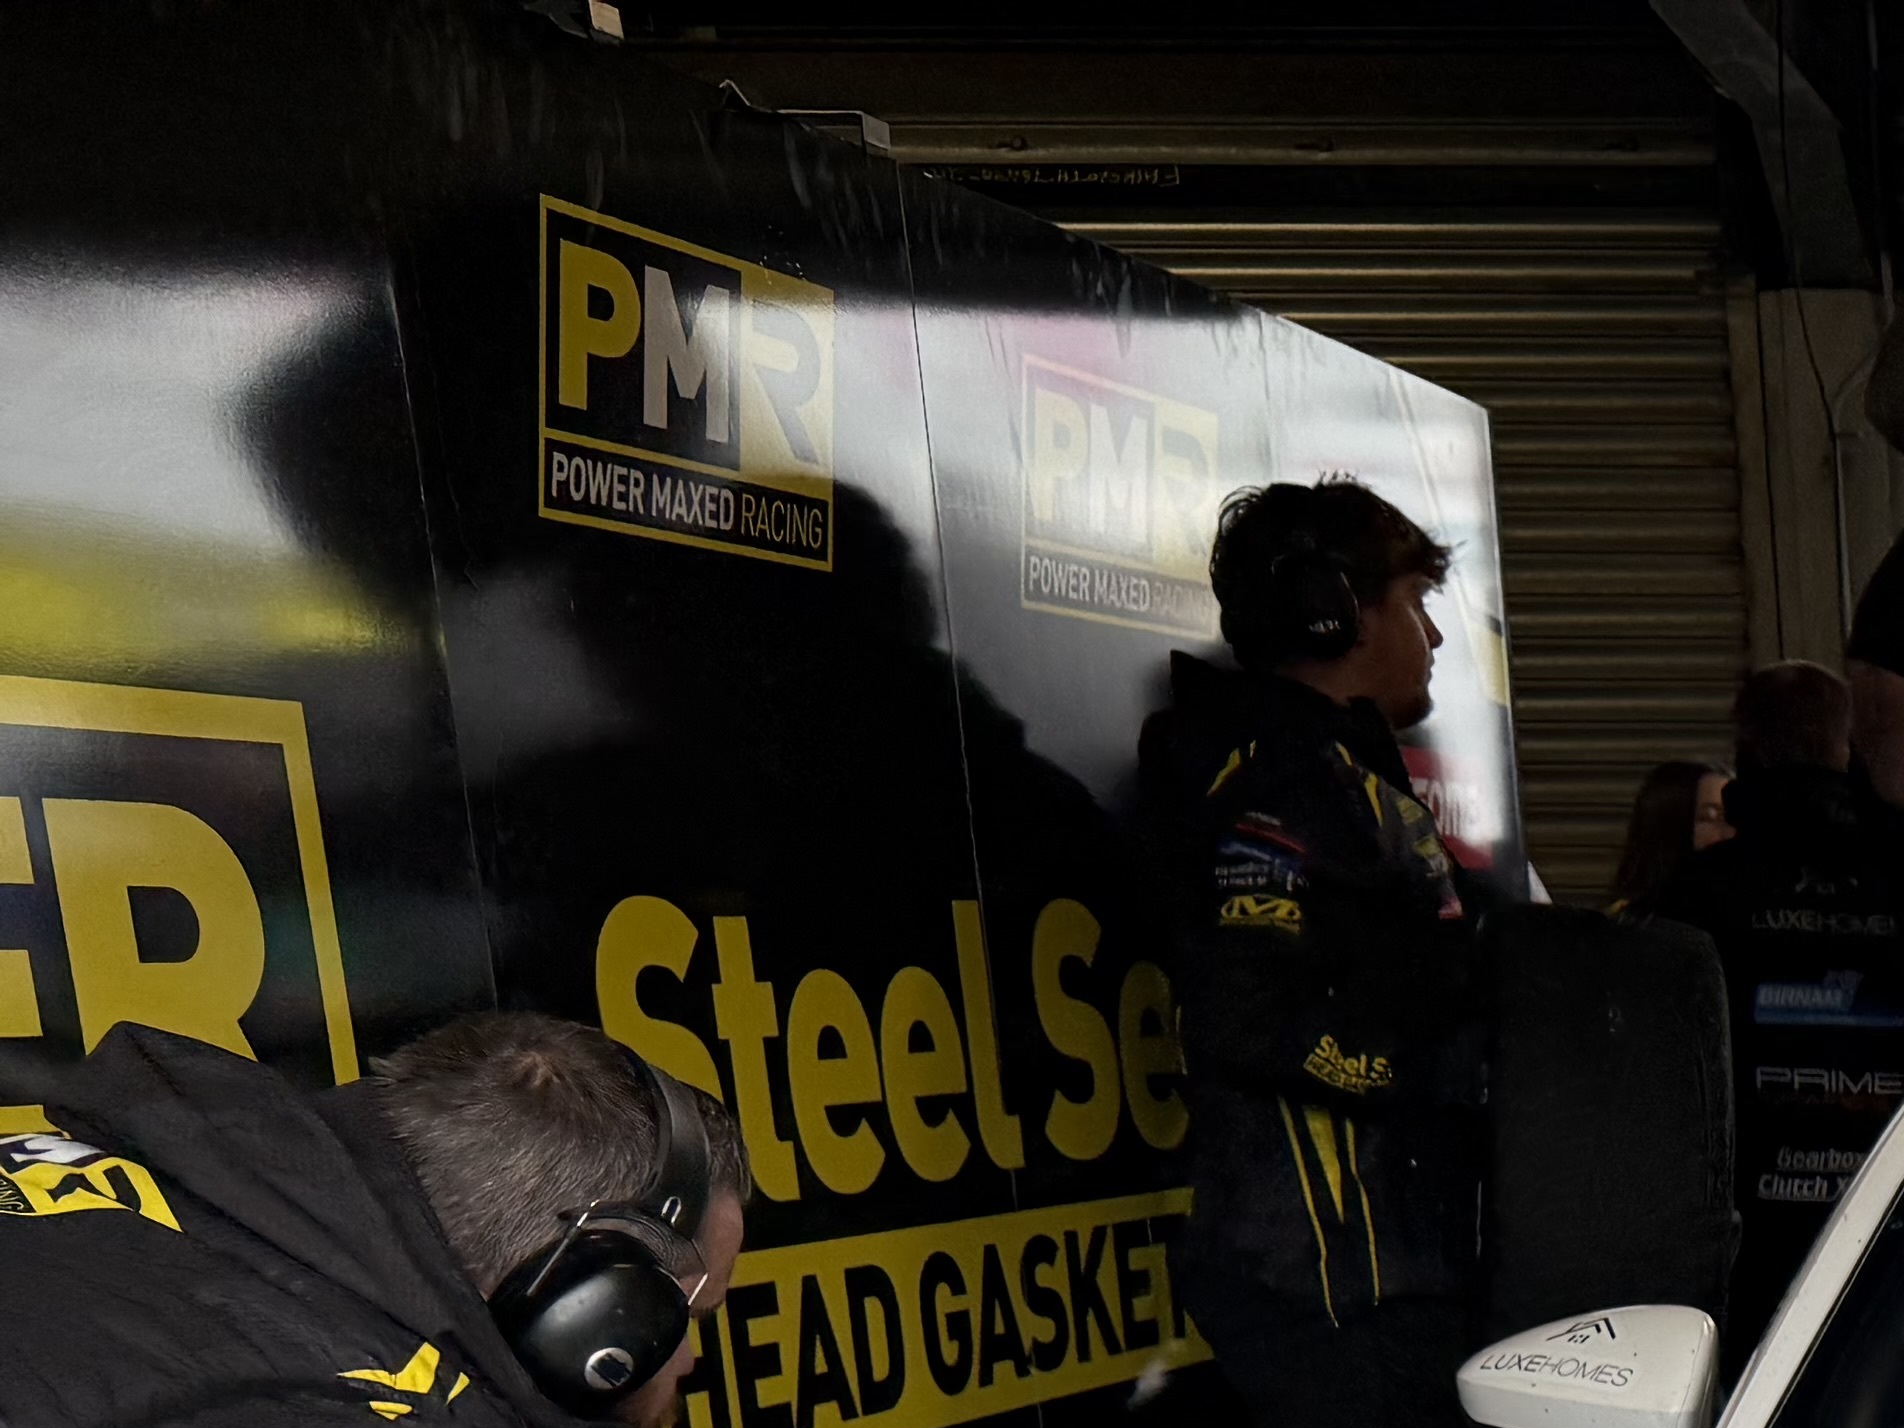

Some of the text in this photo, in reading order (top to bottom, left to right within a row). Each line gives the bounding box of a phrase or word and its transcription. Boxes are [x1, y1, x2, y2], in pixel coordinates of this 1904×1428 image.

[559, 238, 822, 466] PMR
[551, 450, 824, 550] POWER MAXED RACING
[1034, 386, 1212, 557] PMR
[1028, 555, 1090, 601] POWER
[1091, 569, 1151, 614] MAXED
[596, 894, 1190, 1201] Steel Se
[1479, 1353, 1634, 1388] LUXEHOMES
